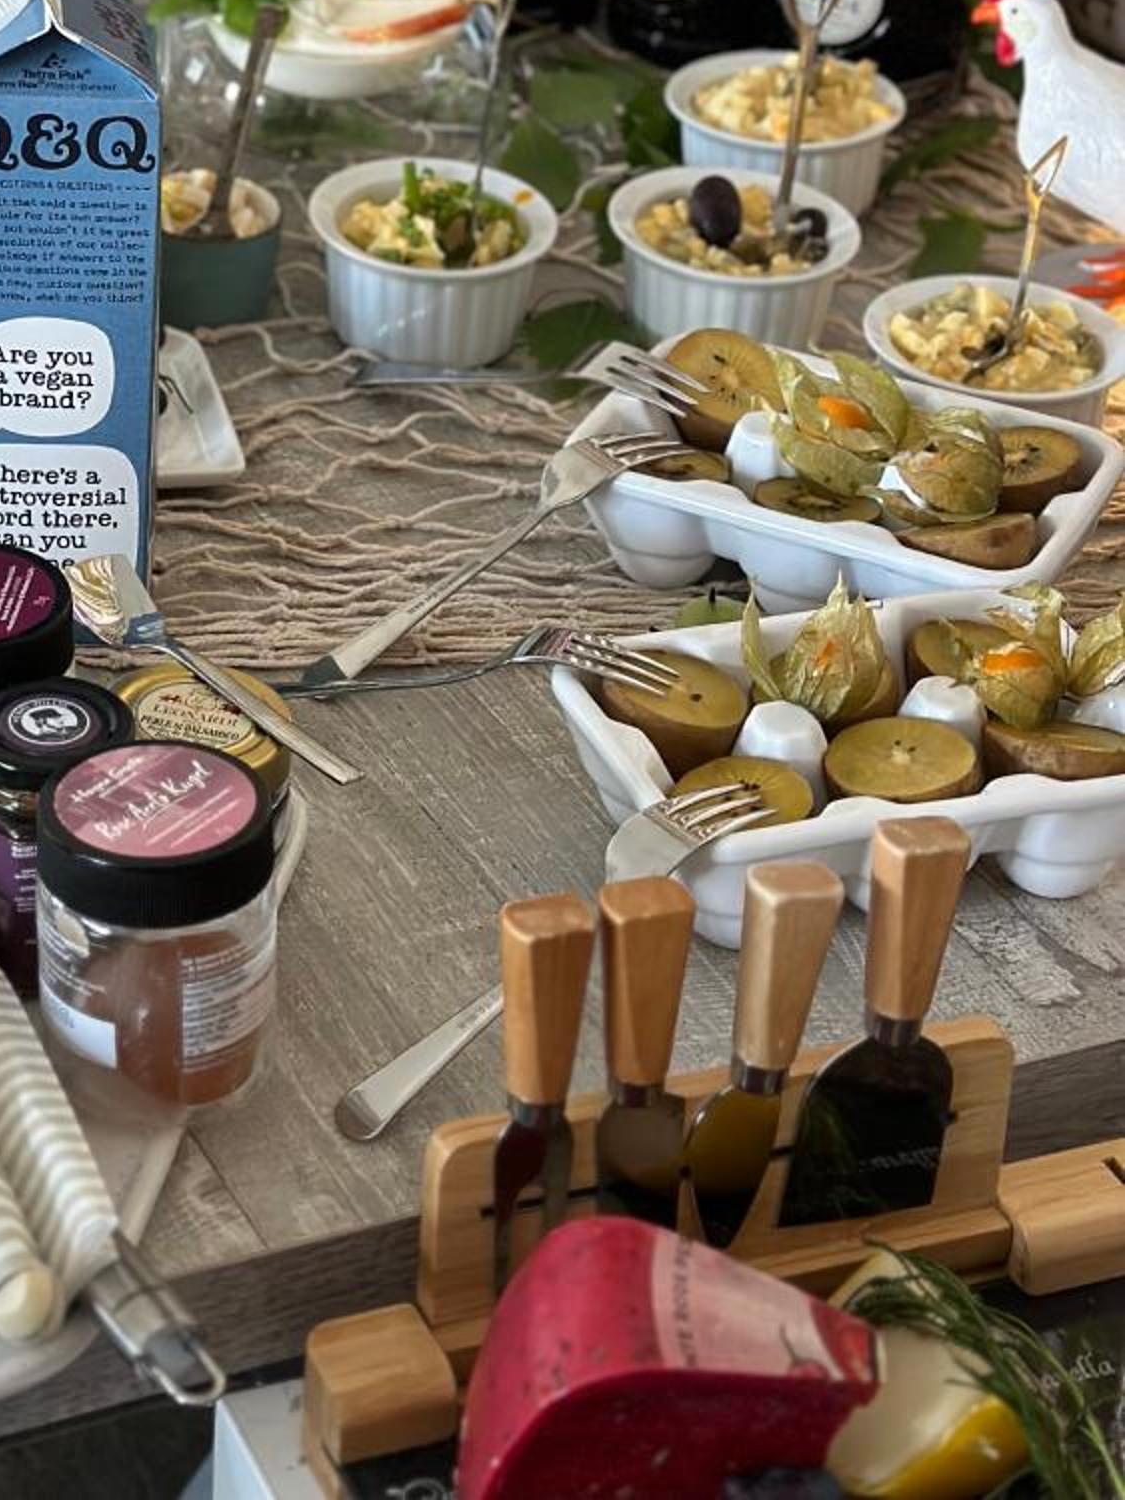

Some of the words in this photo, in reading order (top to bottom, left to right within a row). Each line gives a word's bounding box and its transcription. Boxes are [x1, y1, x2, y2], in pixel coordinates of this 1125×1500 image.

[45, 350, 94, 370] you
[15, 370, 94, 391] vegan
[85, 470, 102, 485] a
[42, 509, 118, 529] there,
[39, 534, 87, 553] you
